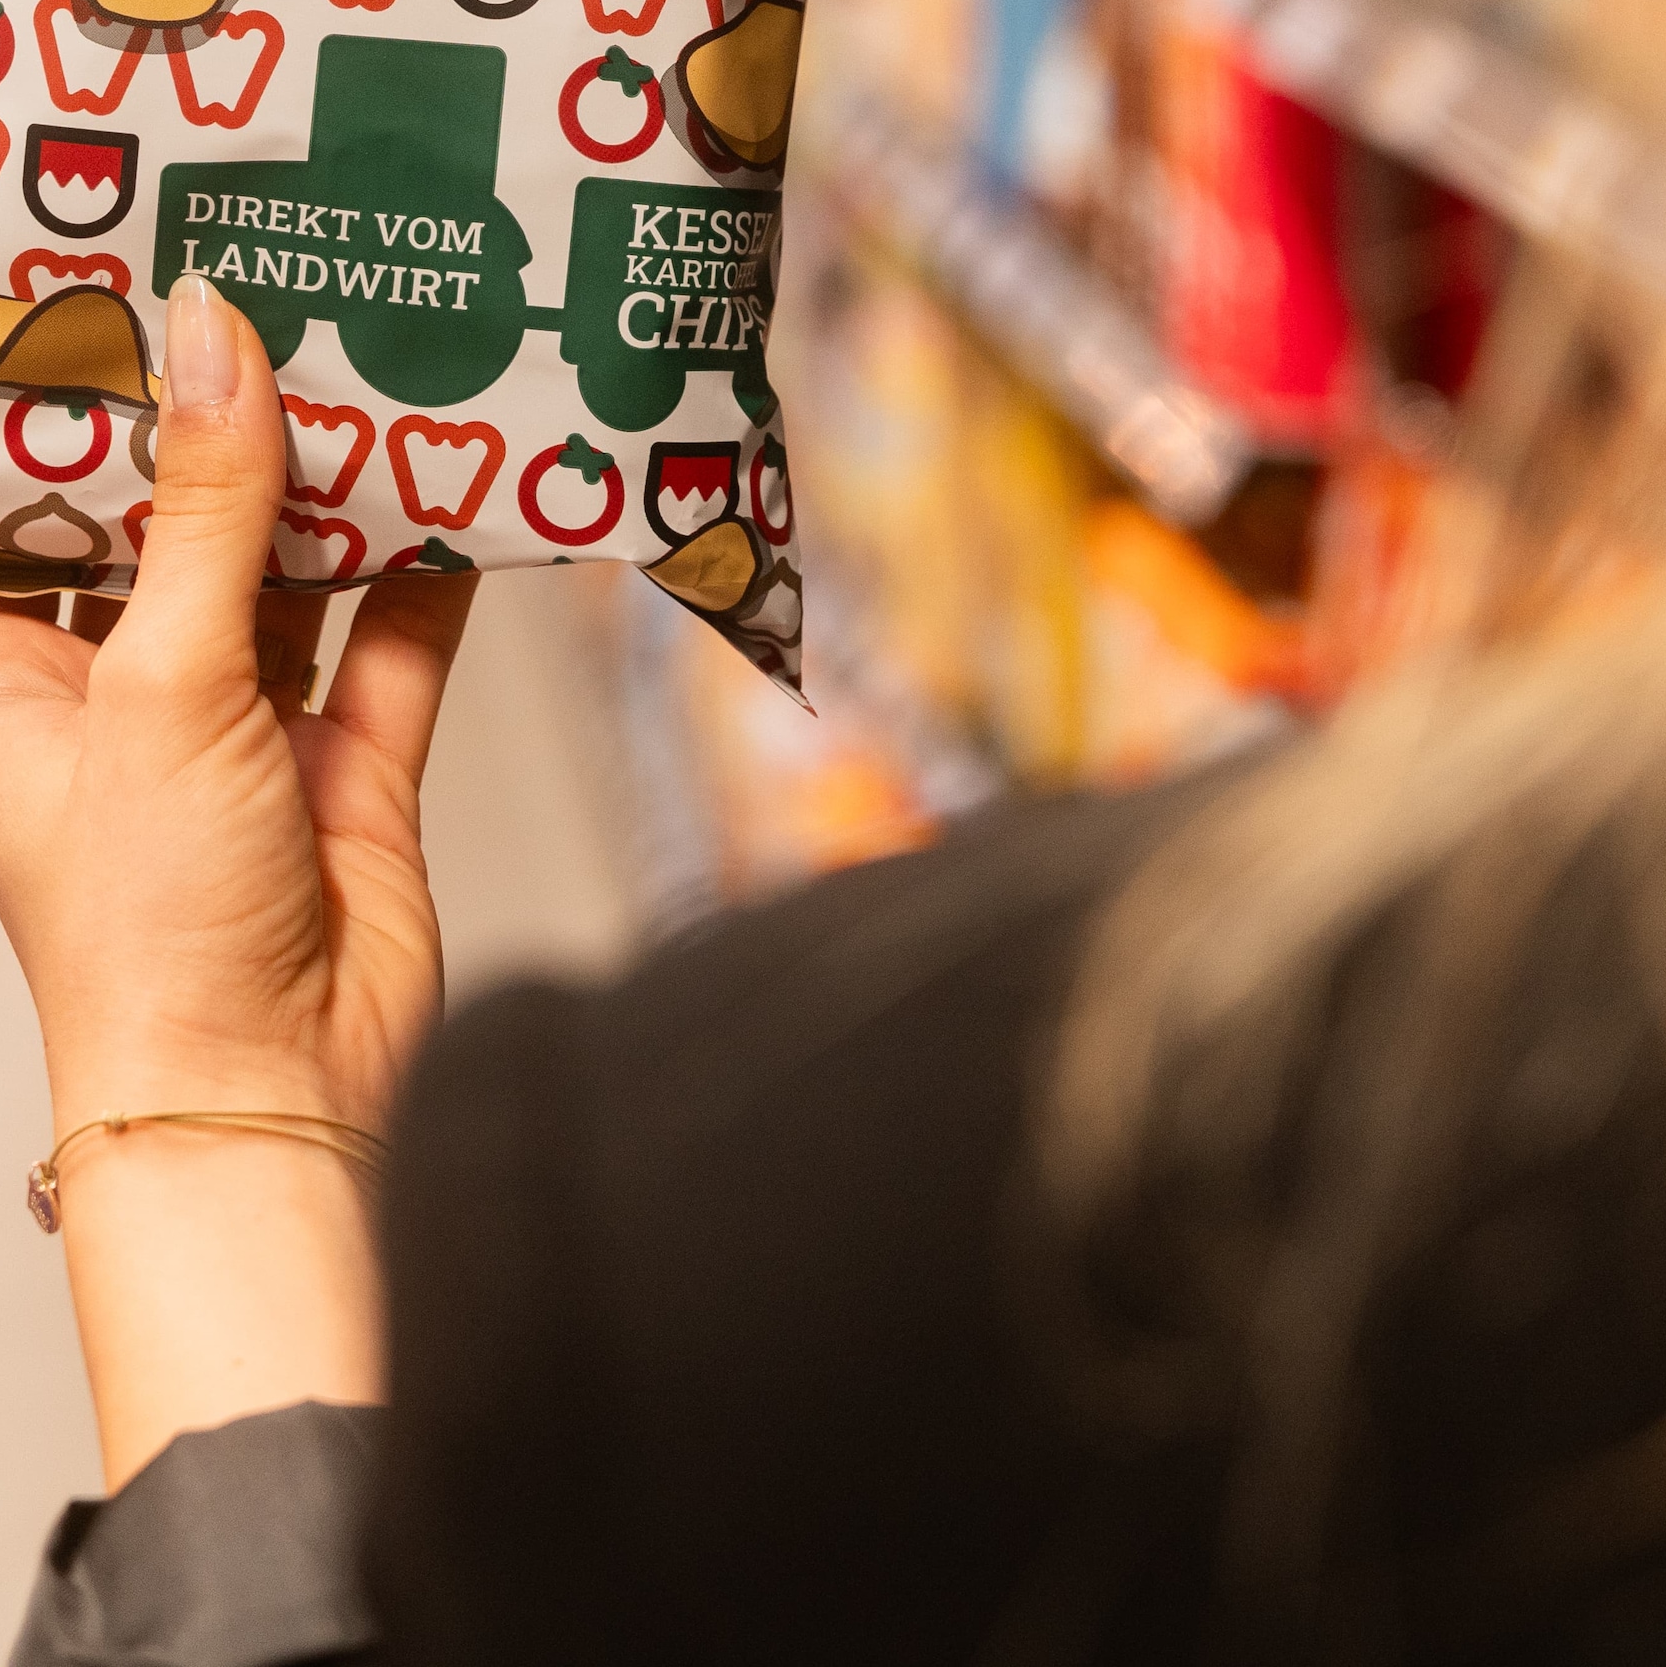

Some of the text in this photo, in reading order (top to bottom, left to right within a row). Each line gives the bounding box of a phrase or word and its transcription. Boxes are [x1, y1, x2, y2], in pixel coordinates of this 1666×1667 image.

[184, 192, 486, 255] DIREKT VOM
[181, 238, 481, 311] LANDWIRT
